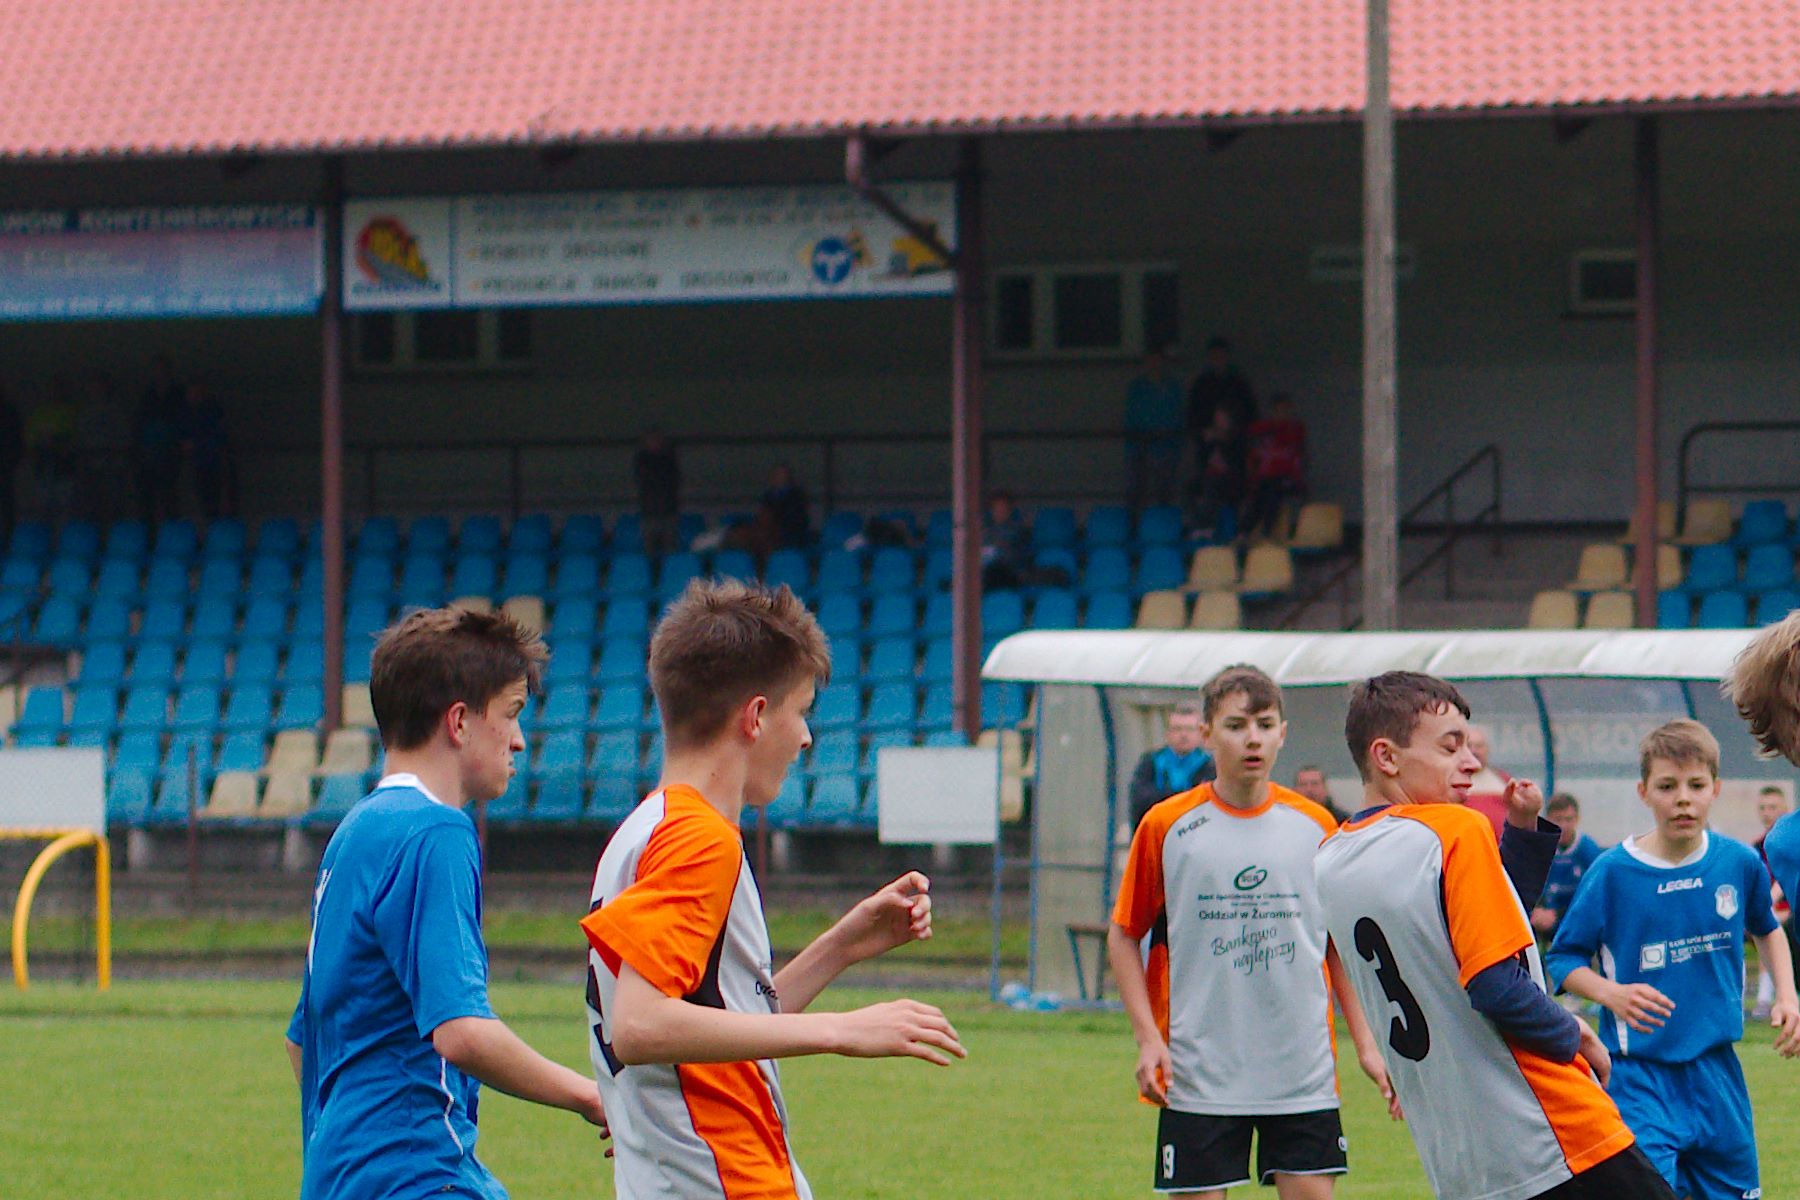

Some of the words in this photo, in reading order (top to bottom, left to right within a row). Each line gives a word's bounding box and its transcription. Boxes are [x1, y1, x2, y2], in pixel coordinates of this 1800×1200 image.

[1657, 878, 1703, 893] LEGEA
[1211, 924, 1278, 957] Bankowo
[1354, 916, 1431, 1062] 3
